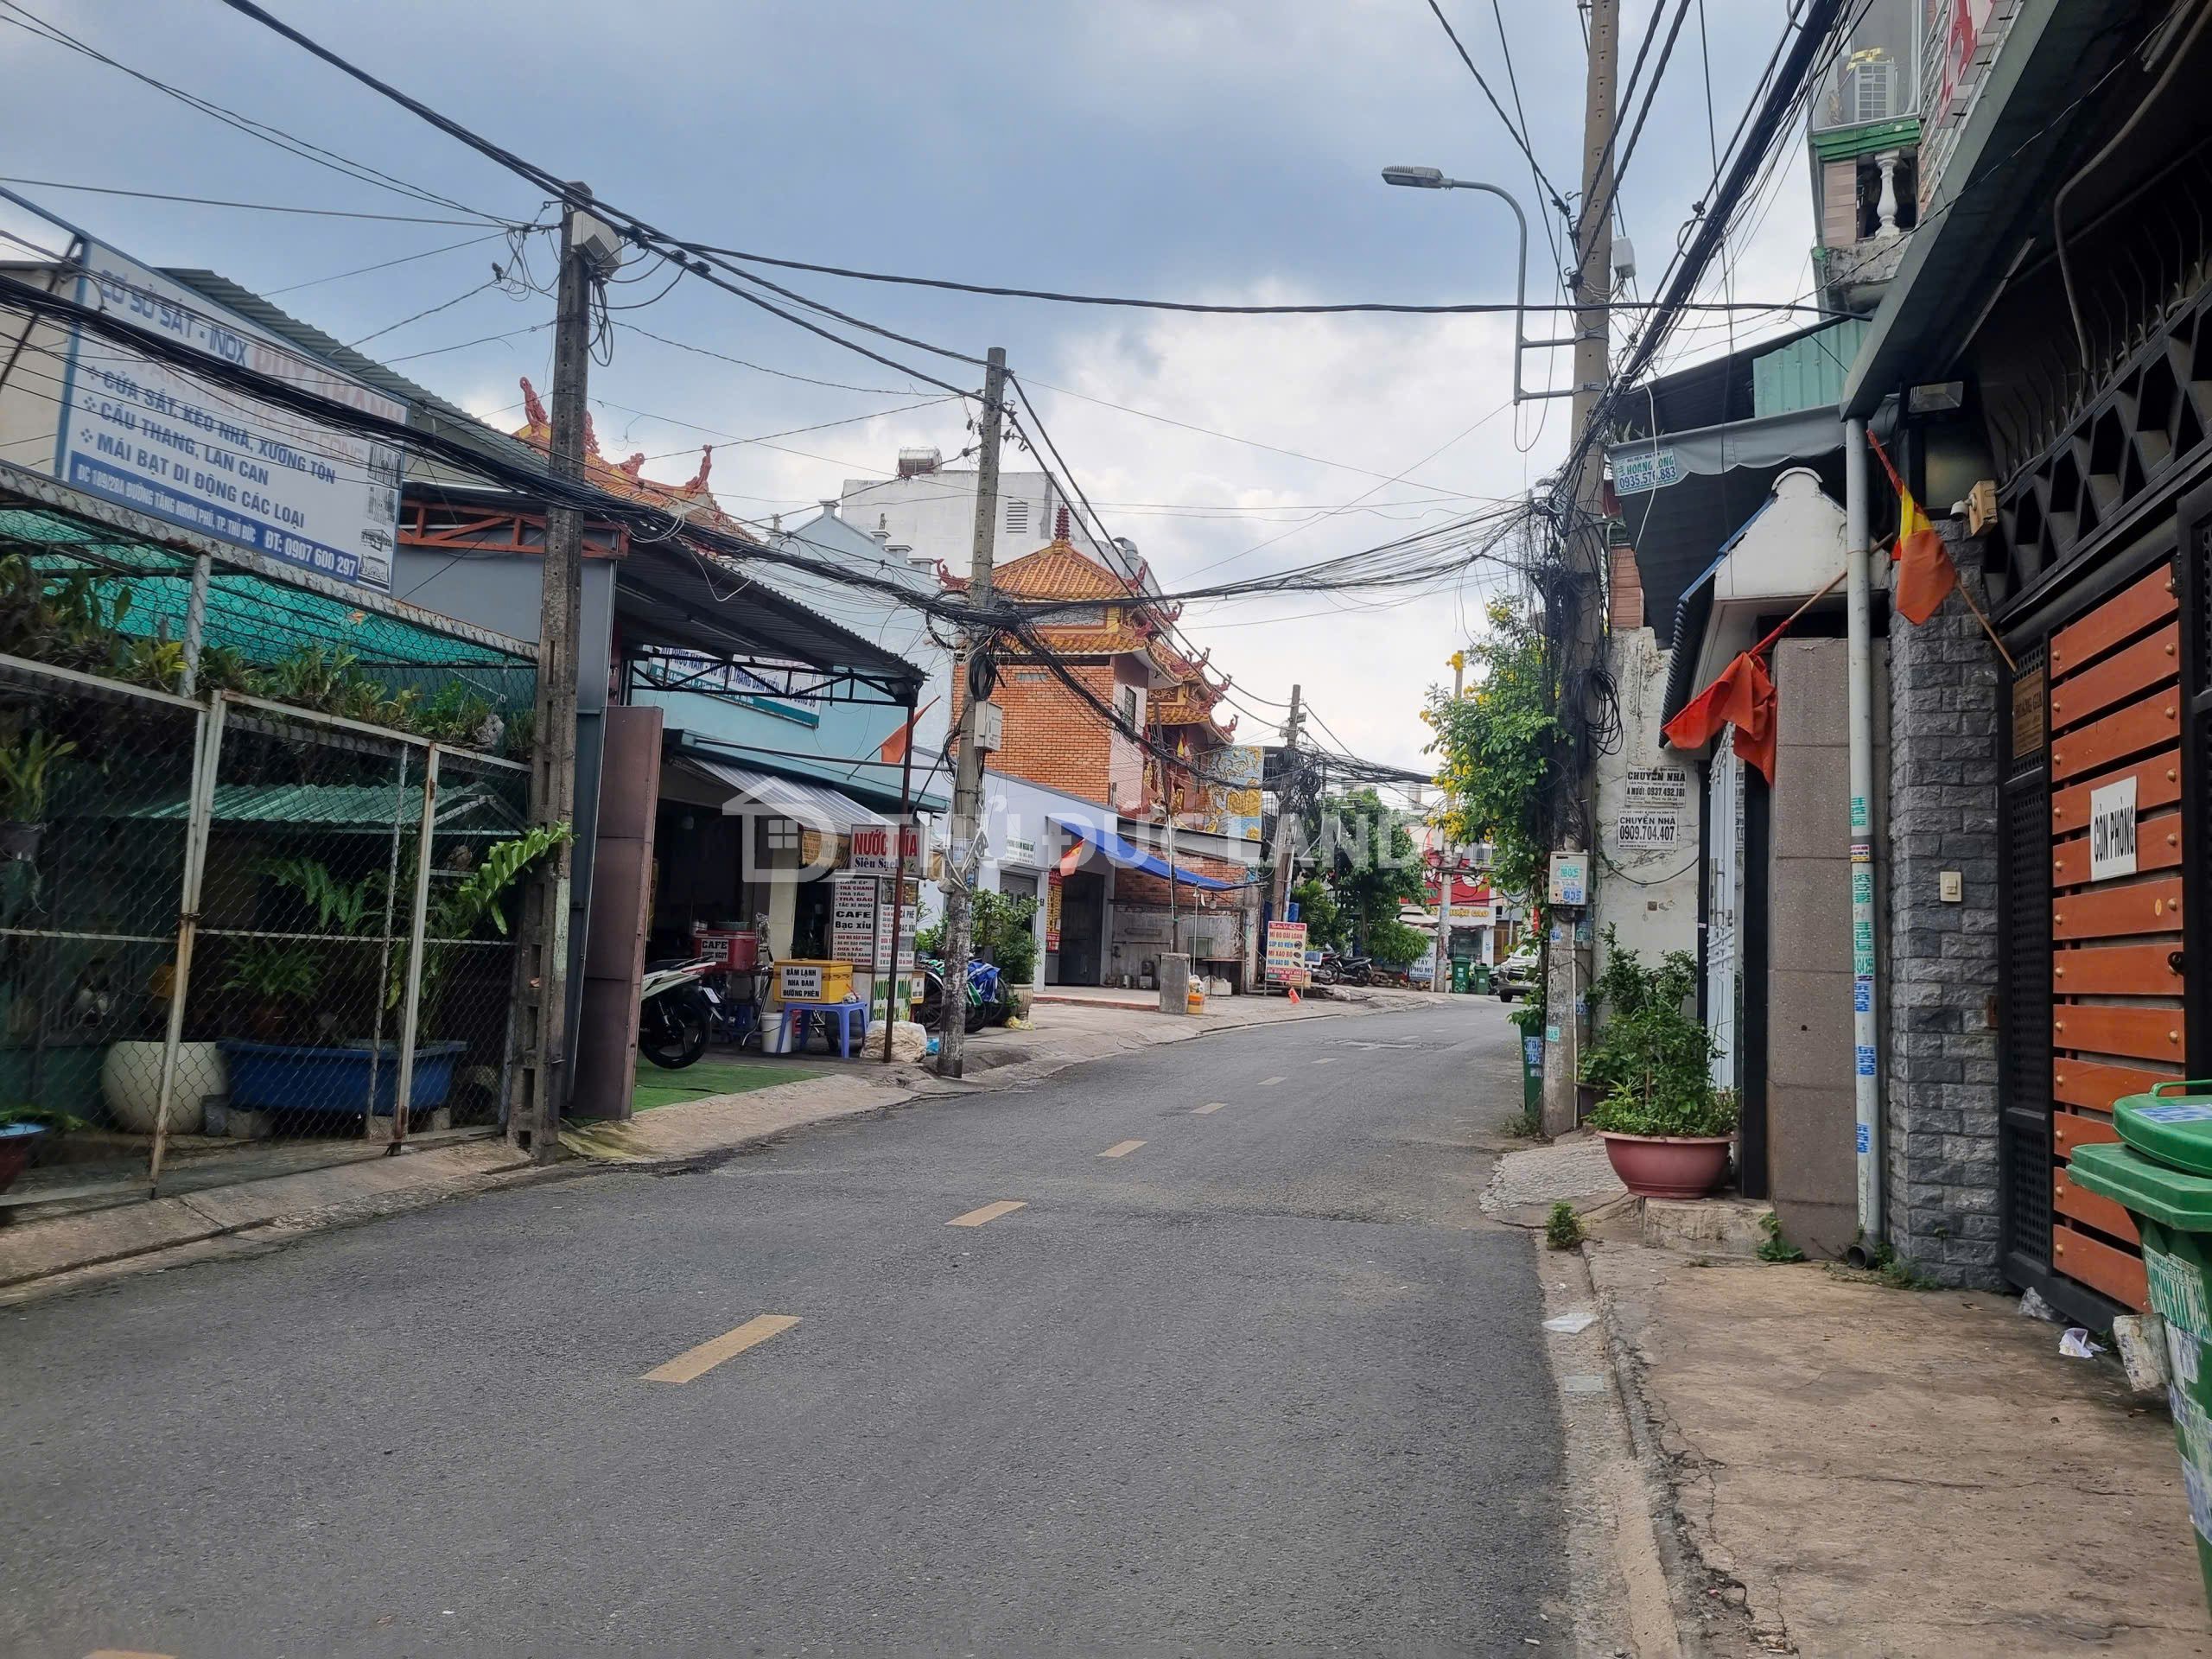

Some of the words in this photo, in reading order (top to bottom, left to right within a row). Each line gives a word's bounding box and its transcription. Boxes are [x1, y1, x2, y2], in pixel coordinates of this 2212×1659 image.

[209, 324, 248, 367] INOX
[100, 402, 137, 430] CẦU
[141, 417, 200, 461] THANG,
[204, 445, 236, 474] LAN
[238, 460, 270, 486] CAN
[1656, 455, 1675, 470] ONG
[96, 432, 132, 463] MÁI
[137, 448, 170, 476] BẠT
[173, 462, 190, 485] DI
[194, 472, 238, 504] ĐỘNG
[241, 491, 271, 516] CÁC
[274, 503, 306, 531] LOẠI
[310, 461, 337, 485] TÔN
[264, 529, 283, 553] ĐT:
[284, 538, 313, 563] 0907
[315, 548, 335, 571] 600
[336, 556, 358, 577] 297
[1667, 770, 1685, 782] NHÀ
[1619, 814, 1656, 825] CHUYỂN
[1657, 815, 1676, 825] NHÀ
[1619, 824, 1675, 841] 0909.704.407
[2094, 803, 2108, 863] CÒN
[2110, 796, 2134, 860] PHÒNG
[853, 829, 888, 856] NƯỚC
[855, 857, 875, 868] Siêu
[835, 921, 853, 930] Bạc
[702, 940, 728, 950] CAFE
[800, 969, 817, 978] LẠNH
